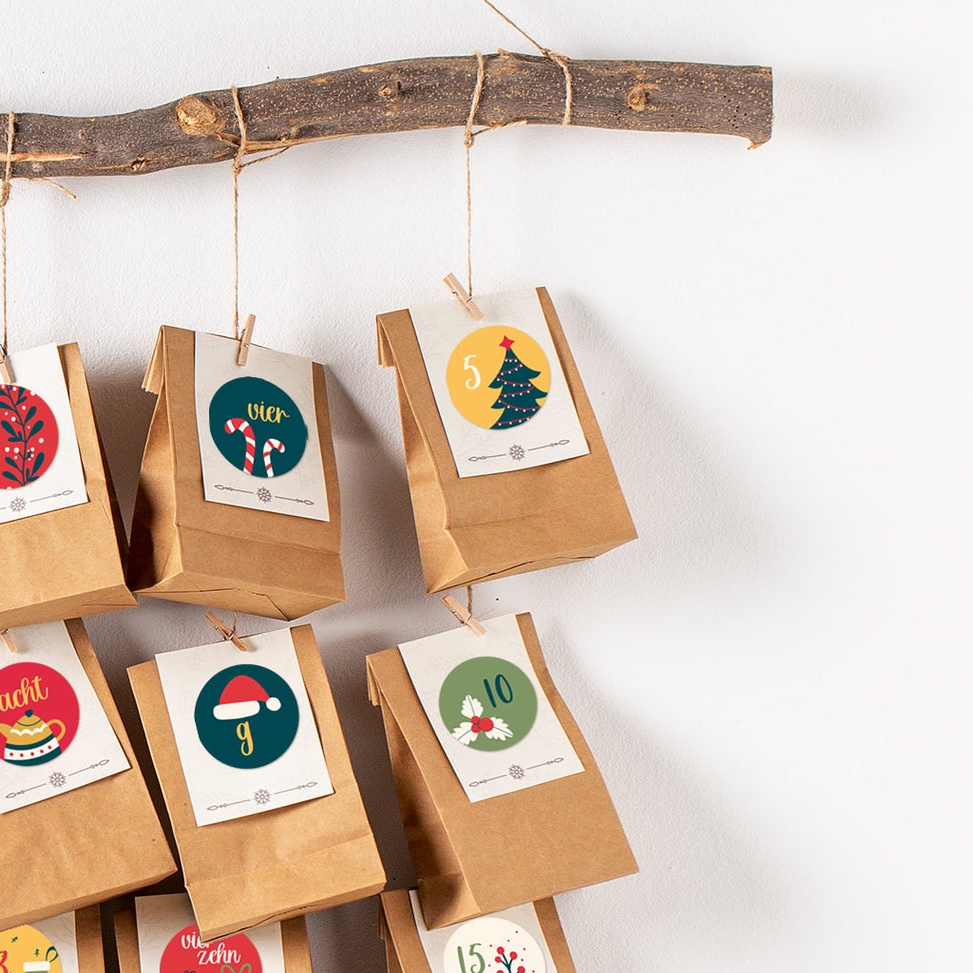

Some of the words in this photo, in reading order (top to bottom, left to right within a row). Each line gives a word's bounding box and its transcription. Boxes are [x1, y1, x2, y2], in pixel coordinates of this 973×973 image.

[462, 354, 481, 391] 5
[247, 401, 290, 424] vier
[483, 674, 513, 708] 10
[196, 942, 242, 966] zehn
